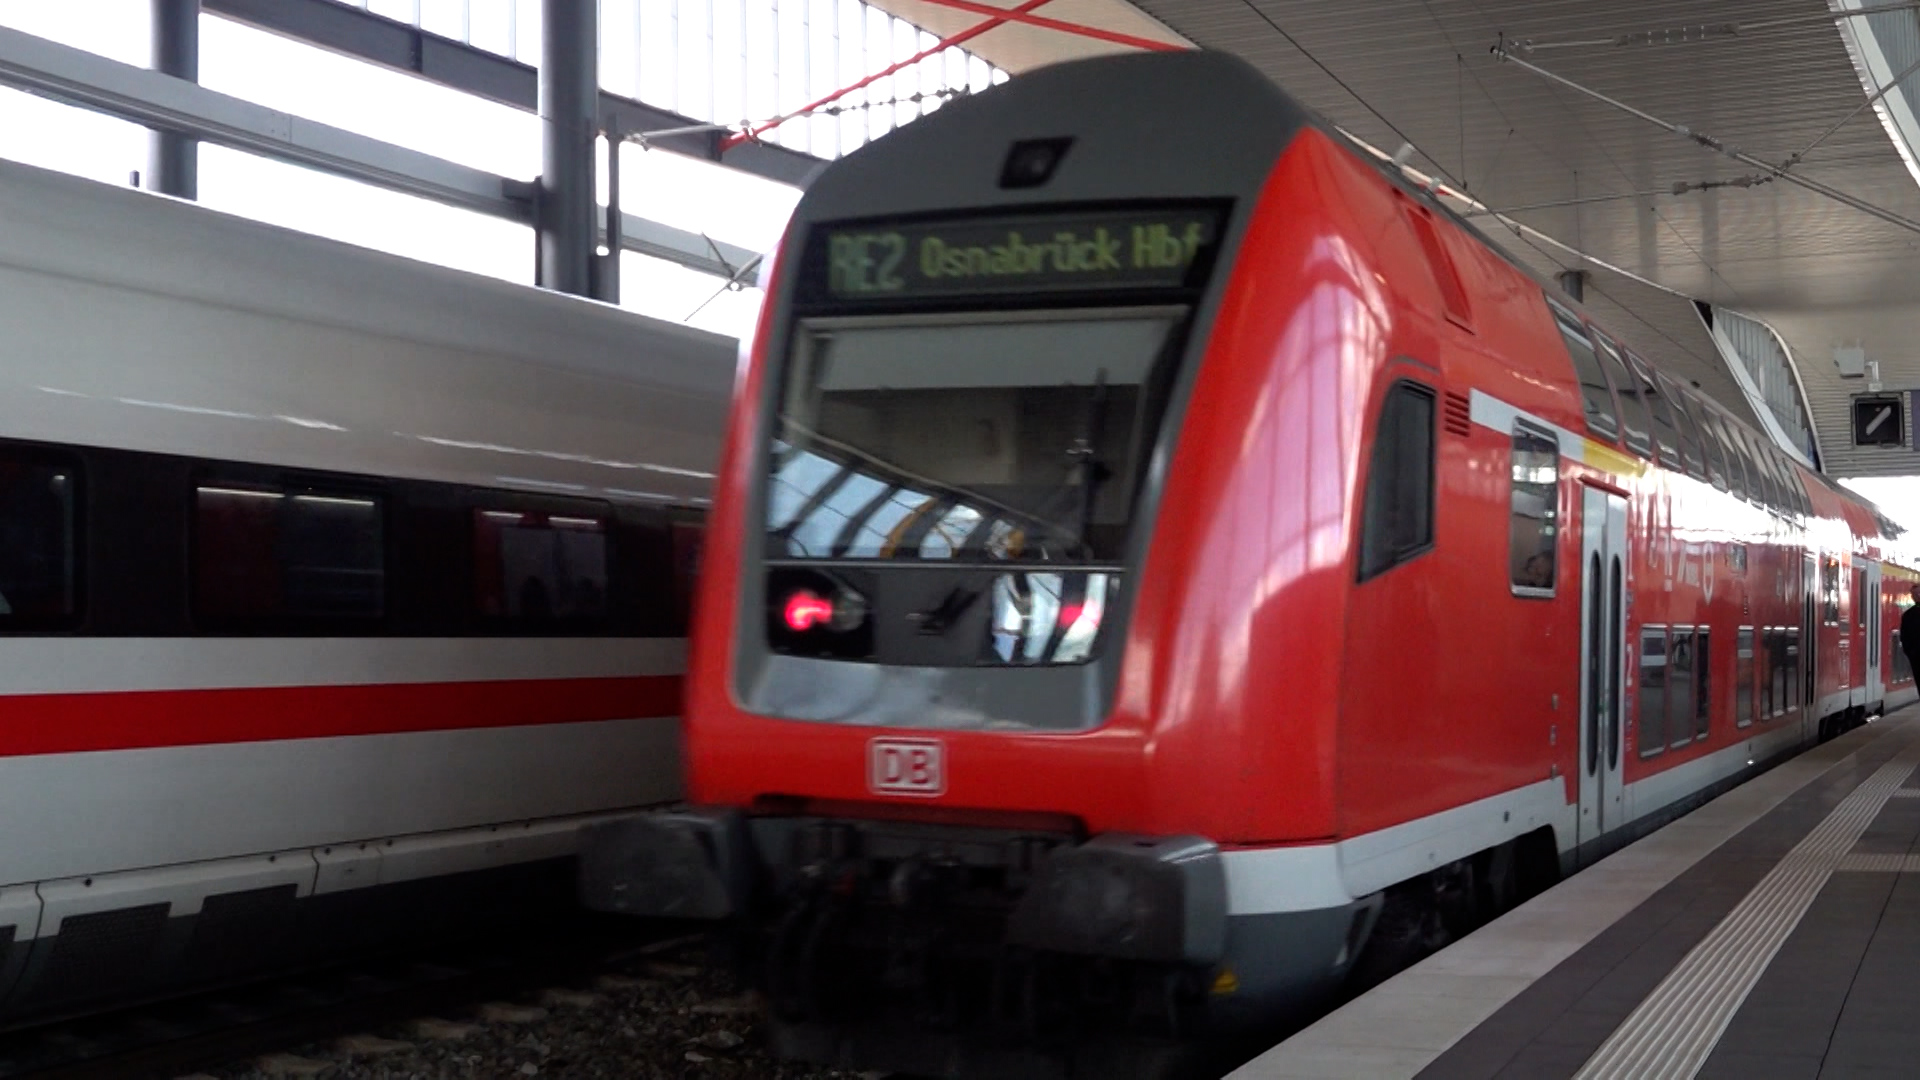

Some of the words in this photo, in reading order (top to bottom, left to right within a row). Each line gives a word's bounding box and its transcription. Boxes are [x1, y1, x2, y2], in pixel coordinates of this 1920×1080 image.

[829, 232, 906, 293] RE2
[921, 226, 1120, 279] Osnabrück
[1133, 223, 1201, 269] Hbf
[879, 747, 934, 785] DB
